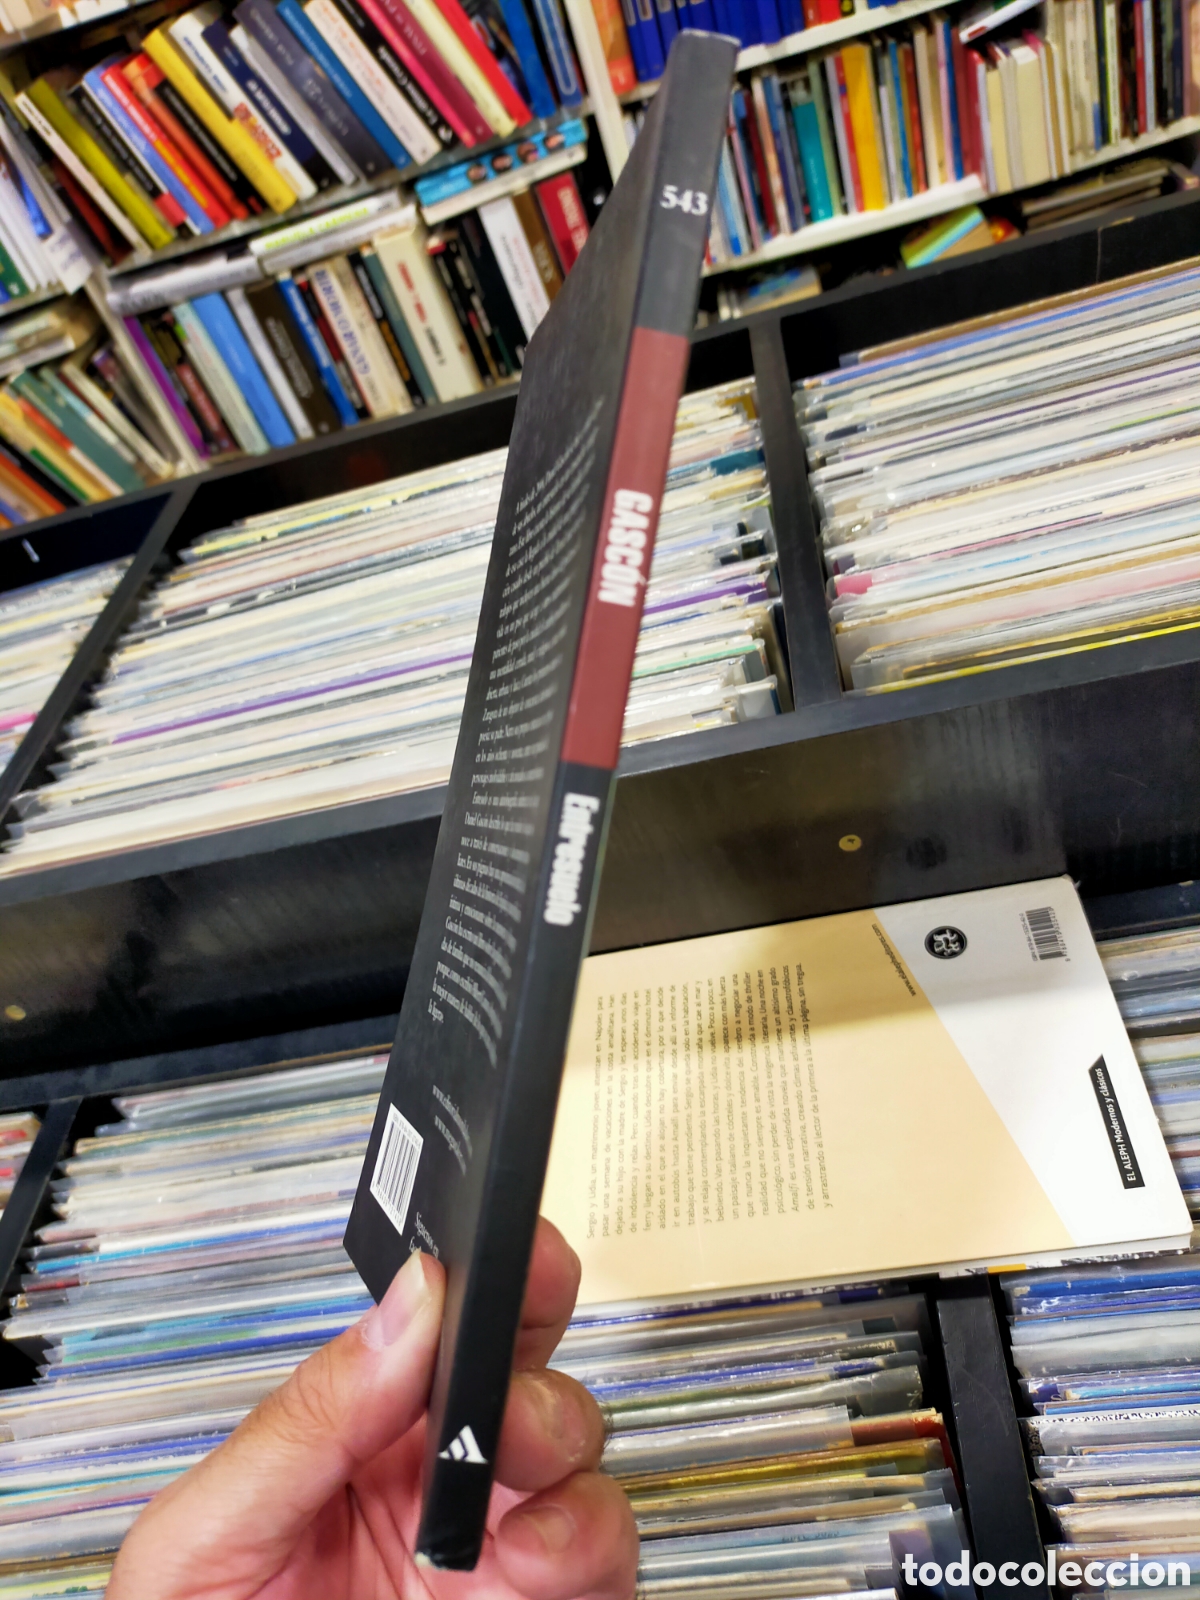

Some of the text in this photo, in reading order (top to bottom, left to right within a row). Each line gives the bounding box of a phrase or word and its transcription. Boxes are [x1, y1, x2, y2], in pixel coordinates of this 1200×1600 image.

[660, 184, 708, 216] 543
[598, 488, 654, 608] GASCÓN
[543, 792, 599, 927] Entresuelo
[871, 923, 917, 996] www.elalepheditores.com
[707, 978, 713, 986] en
[743, 972, 752, 994] thriller
[757, 969, 763, 978] en
[769, 967, 779, 986] grado
[667, 985, 675, 993] de
[718, 976, 726, 996] fuerza
[756, 979, 765, 999] noche
[782, 965, 793, 1016] claustrofóbicos
[796, 986, 805, 997] sin
[668, 995, 676, 1021] informe
[719, 997, 727, 1011] más
[731, 989, 742, 1017] negociar
[745, 995, 753, 1003] de
[758, 1000, 766, 1014] Una
[707, 1011, 715, 1028] Poco
[746, 1005, 754, 1025] modo
[775, 1016, 781, 1026] un
[671, 1024, 676, 1032] un
[684, 1027, 690, 1036] en
[696, 1023, 704, 1036] que
[802, 1024, 810, 1047] última
[682, 1038, 690, 1052] solo
[723, 1026, 731, 1053] aparece
[734, 1027, 743, 1053] cerebro
[775, 1028, 784, 1061] mantiene
[788, 1023, 798, 1061] asfixiantes
[669, 1048, 677, 1069] desde
[695, 1038, 704, 1069] montaña
[711, 1055, 717, 1064] no
[736, 1057, 744, 1068] del
[748, 1033, 758, 1072] Construida
[762, 1045, 773, 1079] exigencia
[683, 1053, 693, 1075] queda
[709, 1066, 718, 1083] Lidia
[780, 1064, 788, 1078] que
[670, 1072, 678, 1094] enviar
[686, 1077, 691, 1085] se
[792, 1064, 801, 1087] climas
[807, 1063, 818, 1093] primera
[1095, 1068, 1110, 1096] clásicos
[684, 1087, 694, 1110] Sergio
[696, 1071, 707, 1108] escarpada
[737, 1070, 747, 1108] tendencia
[766, 1089, 775, 1108] vista
[779, 1080, 788, 1105] novela
[809, 1094, 817, 1102] la
[725, 1098, 734, 1130] cócteles
[755, 1105, 761, 1114] es
[768, 1110, 776, 1120] de
[794, 1090, 804, 1121] creando
[811, 1104, 818, 1113] de
[671, 1116, 679, 1142] Amalfi
[712, 1115, 720, 1126] las
[756, 1115, 765, 1147] siempre
[782, 1107, 794, 1150] espléndida
[813, 1116, 822, 1139] lector
[1106, 1104, 1124, 1142] Modernos
[712, 1128, 723, 1161] pasando
[727, 1132, 734, 1142] de
[741, 1111, 751, 1157] inquietante
[769, 1122, 780, 1148] perder
[671, 1144, 679, 1166] hasta
[698, 1120, 709, 1177] contemplando
[728, 1143, 736, 1175] italiano
[759, 1149, 765, 1160] no
[771, 1150, 779, 1162] sin
[1118, 1144, 1133, 1169] ALEPH
[686, 1154, 694, 1175] tiene
[714, 1163, 722, 1178] Van
[743, 1160, 750, 1168] la
[760, 1163, 768, 1178] que
[817, 1150, 829, 1200] arrastrando
[672, 1169, 680, 1203] autobús
[688, 1177, 696, 1192] que
[790, 1171, 796, 1180] es
[803, 1164, 813, 1196] tensión
[1127, 1171, 1136, 1181] EL
[700, 1180, 710, 1203] relaja
[729, 1176, 740, 1206] paisaje
[759, 1181, 769, 1216] realidad
[788, 1183, 799, 1212] Amalfi
[674, 1206, 680, 1217] en
[686, 1194, 696, 1225] trabajo
[703, 1206, 709, 1215] se
[733, 1208, 739, 1219] un
[747, 1201, 755, 1217] que
[807, 1199, 814, 1210] de
